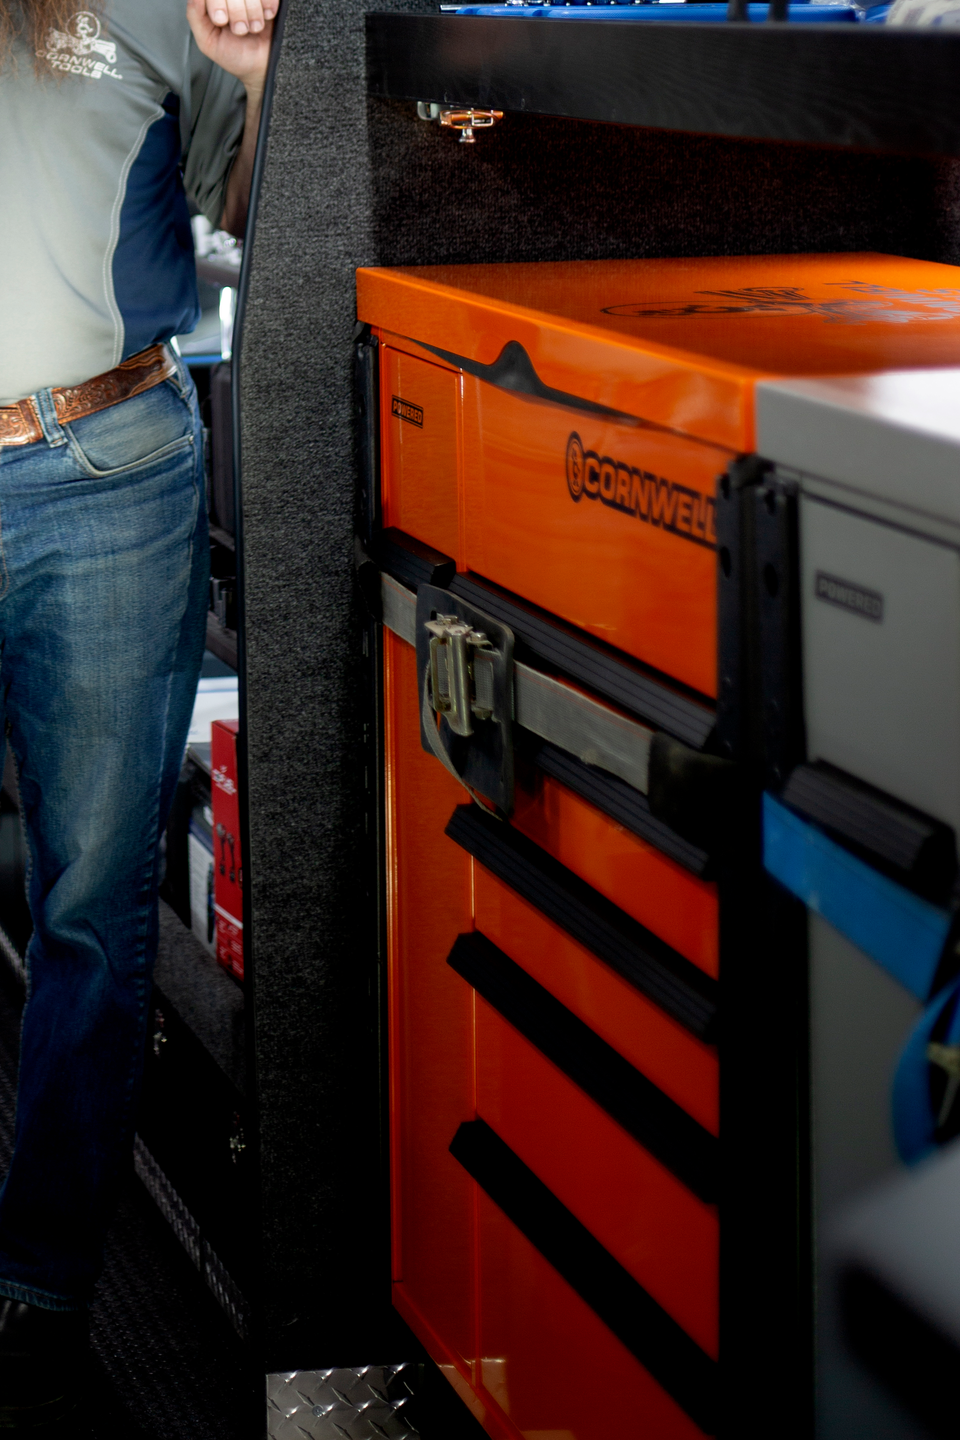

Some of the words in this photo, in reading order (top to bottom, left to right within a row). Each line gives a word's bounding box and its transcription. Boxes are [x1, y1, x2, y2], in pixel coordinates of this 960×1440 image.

[35, 49, 123, 80] CORNWELL
[51, 60, 102, 79] TOOLS
[392, 399, 423, 424] POWERED
[818, 578, 881, 615] POWERED
